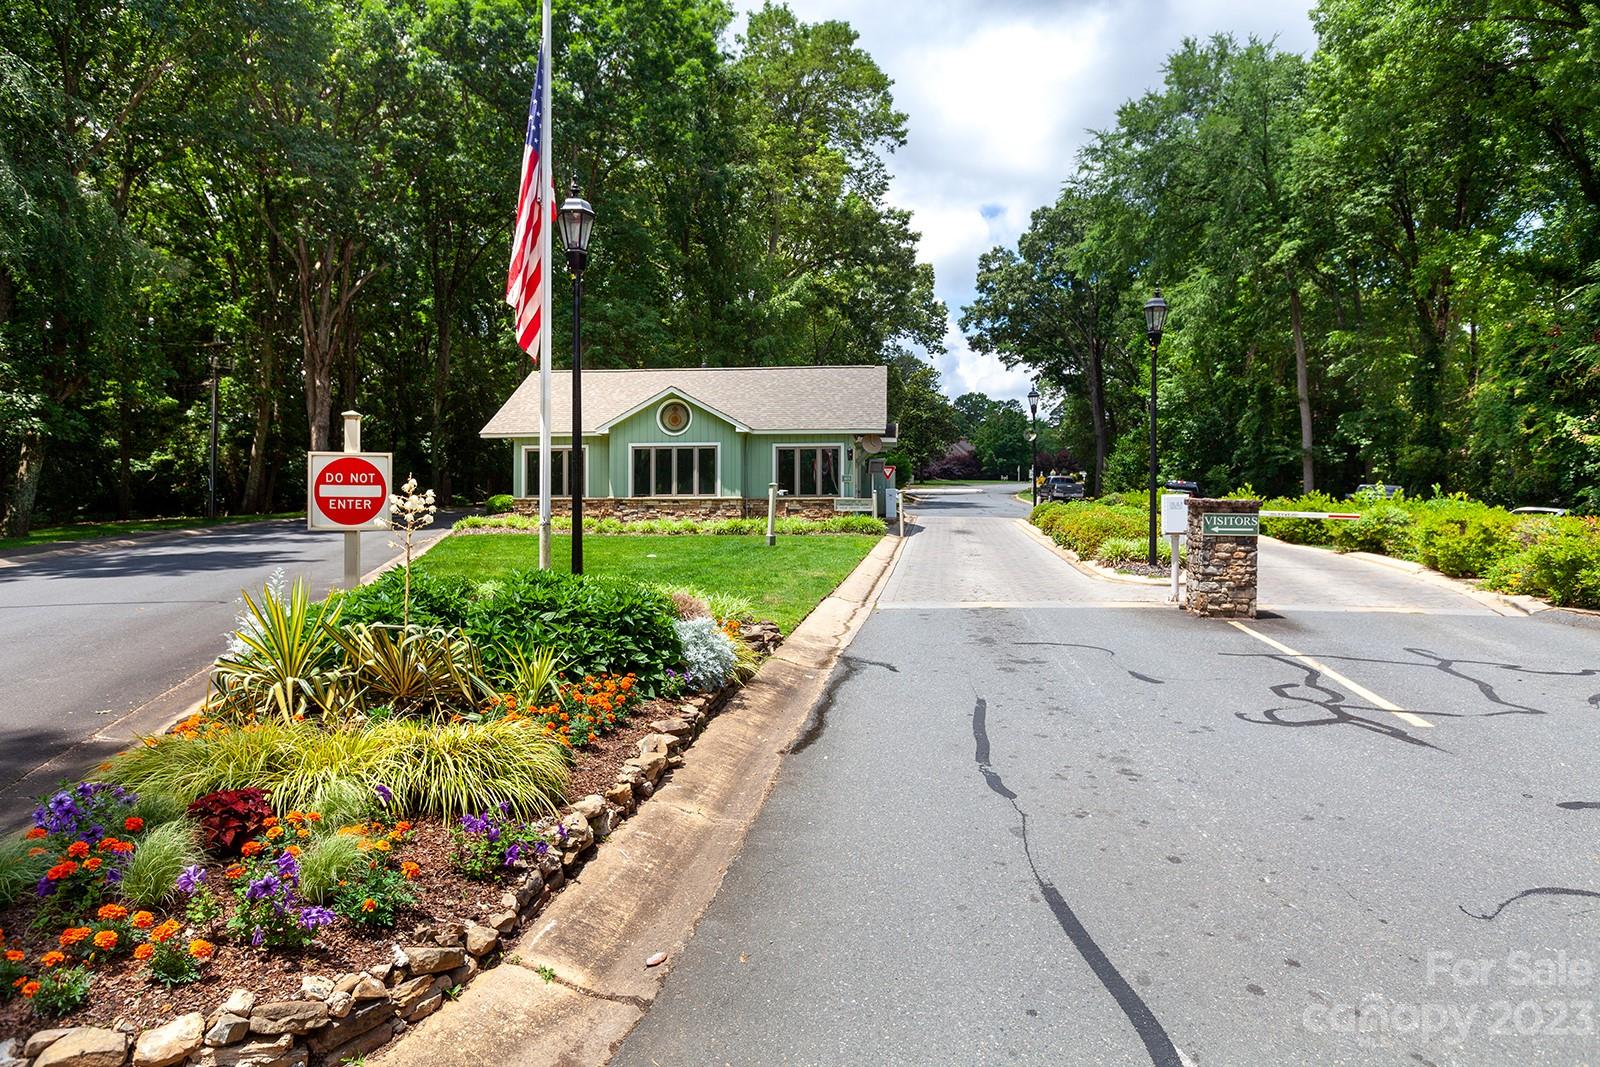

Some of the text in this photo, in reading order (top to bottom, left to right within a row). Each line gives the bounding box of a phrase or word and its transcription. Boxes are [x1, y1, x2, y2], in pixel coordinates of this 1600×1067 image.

[325, 472, 376, 483] DO NOT
[329, 499, 372, 510] ENTER
[1204, 516, 1258, 526] VISITORS
